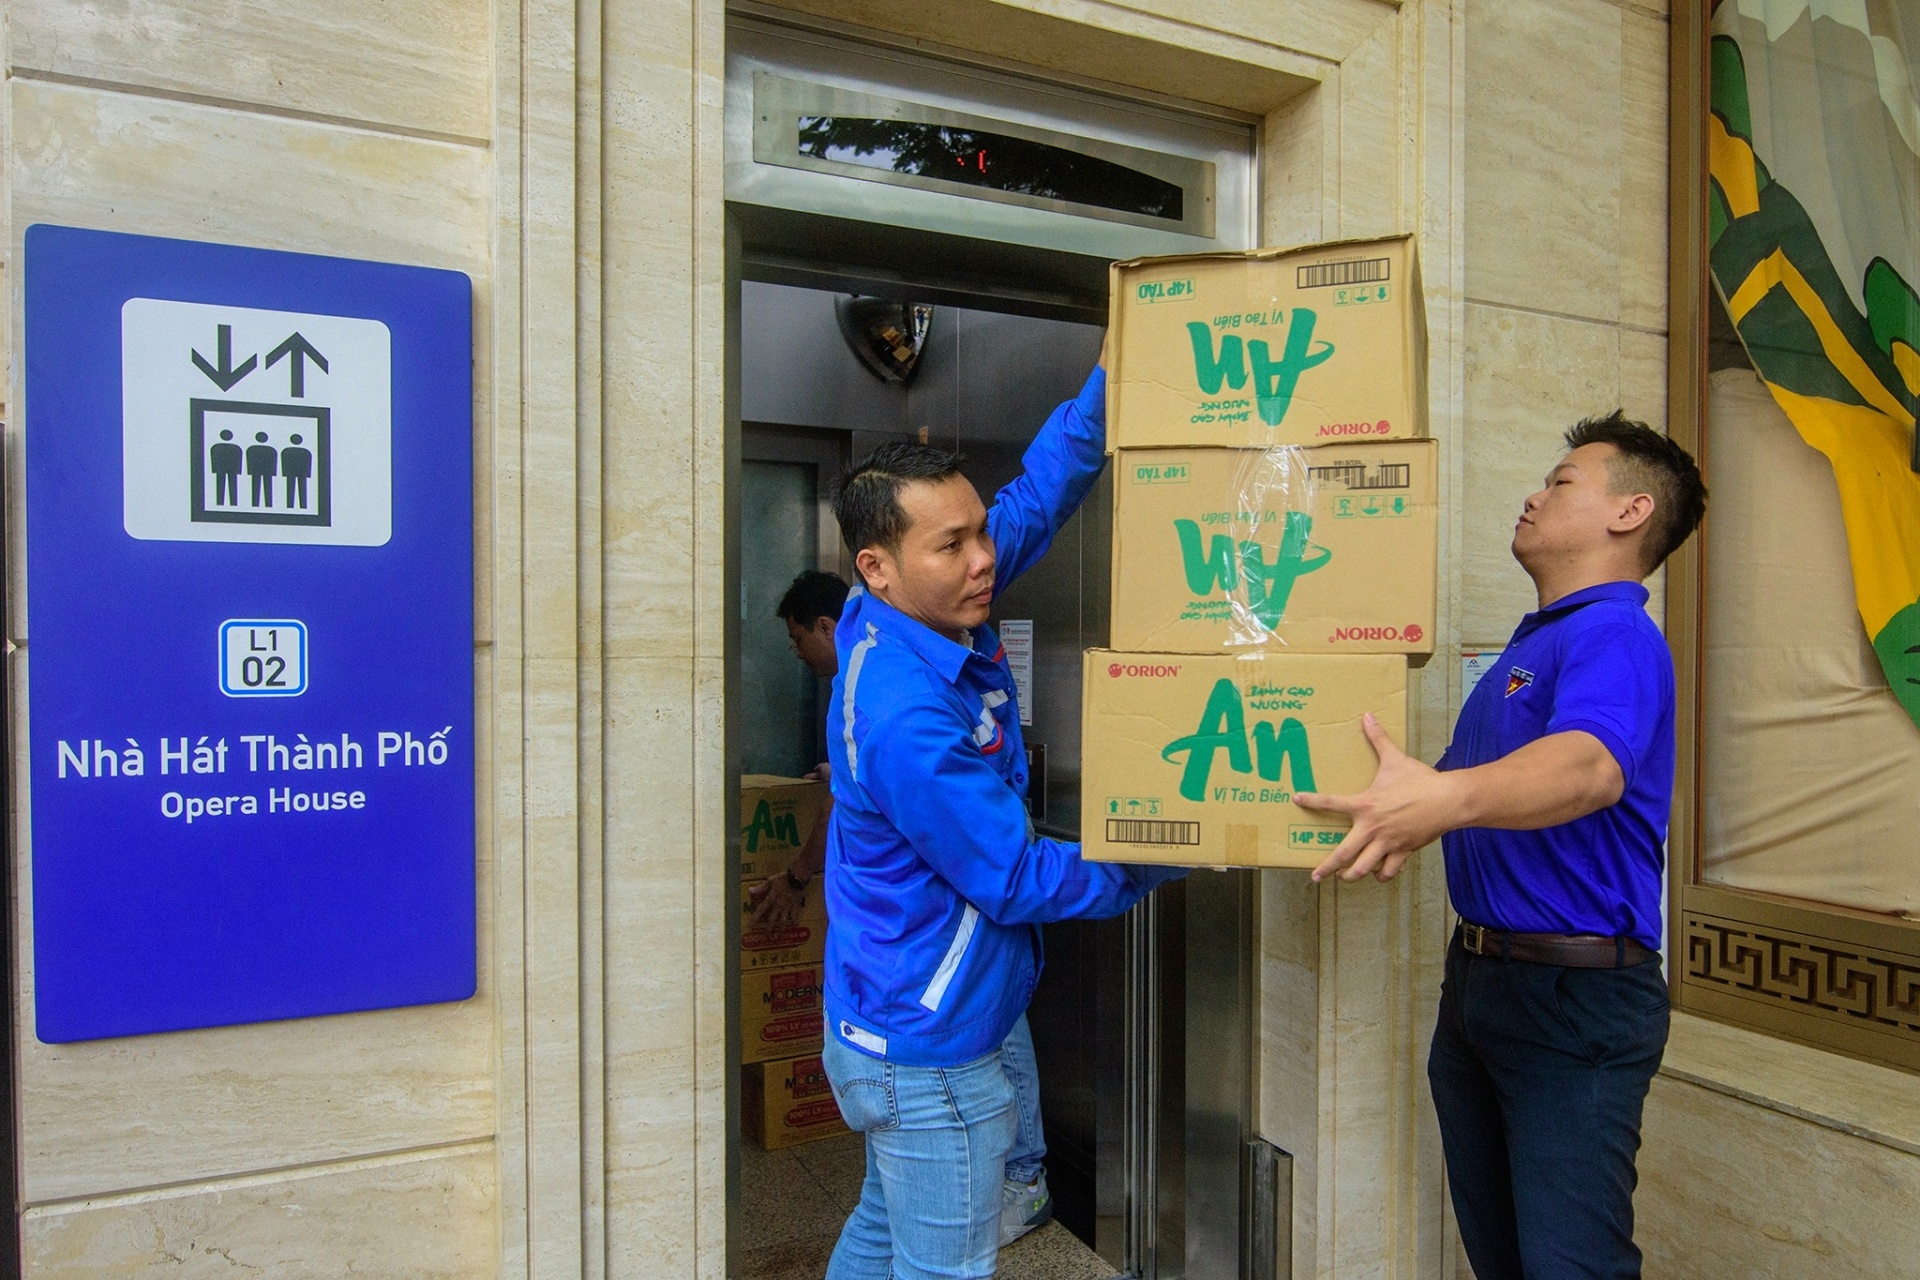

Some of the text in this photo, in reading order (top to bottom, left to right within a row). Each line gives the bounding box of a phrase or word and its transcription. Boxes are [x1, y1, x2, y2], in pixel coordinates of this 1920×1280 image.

[1138, 279, 1194, 304] 14P TẢO
[1271, 309, 1284, 325] Vị
[1186, 307, 1336, 427] An
[1320, 421, 1372, 436] ORION
[1136, 466, 1187, 483] 14P TẢO
[1263, 510, 1277, 523] Vị
[1173, 511, 1332, 631] An
[249, 629, 278, 651] L1
[1335, 626, 1399, 642] ORION
[241, 656, 287, 687] 02
[1125, 663, 1178, 678] ORION
[1160, 677, 1318, 803] An
[57, 725, 454, 779] Nhà Hát Thành Phố
[161, 787, 367, 824] Opera House
[1213, 786, 1228, 805] Vị
[740, 799, 801, 854] An
[1290, 831, 1348, 845] 14P SEA
[763, 984, 824, 1004] MODERN
[785, 1073, 825, 1090] MODE
